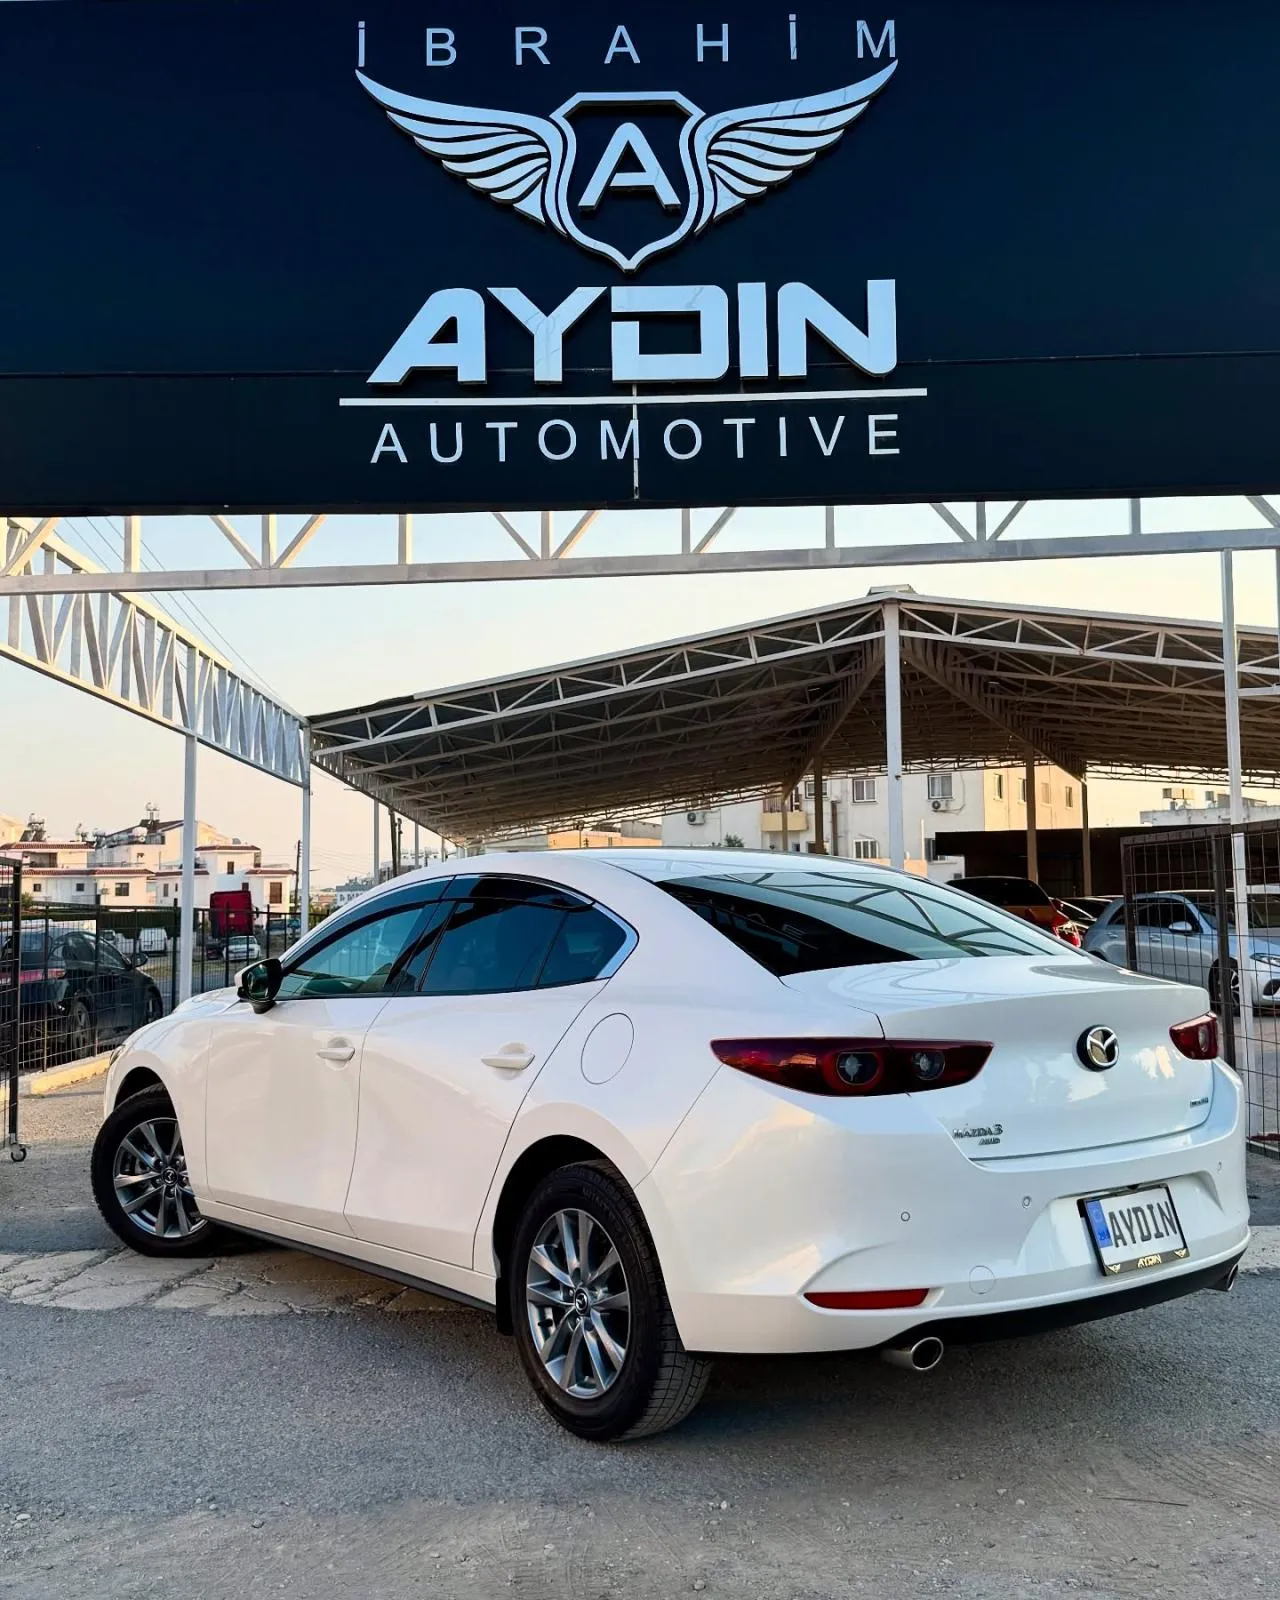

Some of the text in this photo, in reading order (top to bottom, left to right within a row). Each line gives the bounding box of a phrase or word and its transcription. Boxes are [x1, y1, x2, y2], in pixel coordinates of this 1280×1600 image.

[358, 14, 898, 67] İBRAHİM
[578, 122, 681, 209] A
[366, 279, 897, 384] AYDIN
[371, 414, 900, 463] AUTOMOTIVE
[1108, 1201, 1177, 1248] AYDIN
[1137, 1254, 1162, 1268] AYDIN
